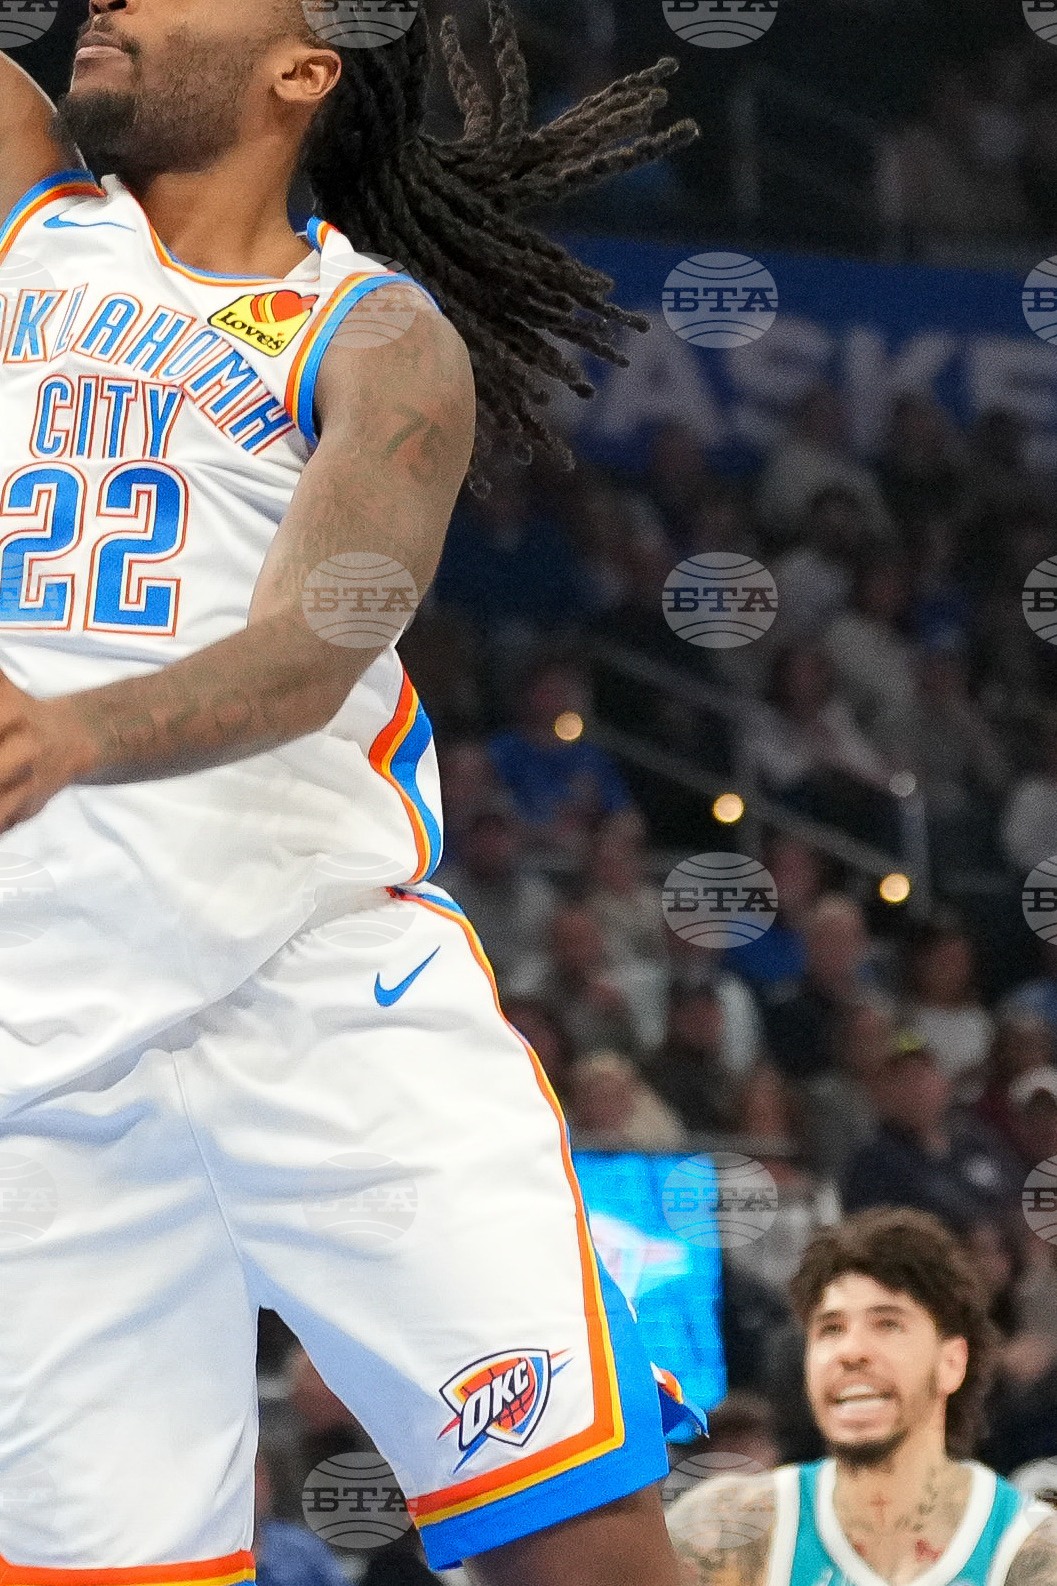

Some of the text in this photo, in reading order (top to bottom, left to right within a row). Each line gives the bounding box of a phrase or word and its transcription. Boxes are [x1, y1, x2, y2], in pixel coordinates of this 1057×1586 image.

[29, 374, 185, 460] CITY
[543, 310, 1057, 459] ASKE
[459, 1359, 531, 1452] OKC
